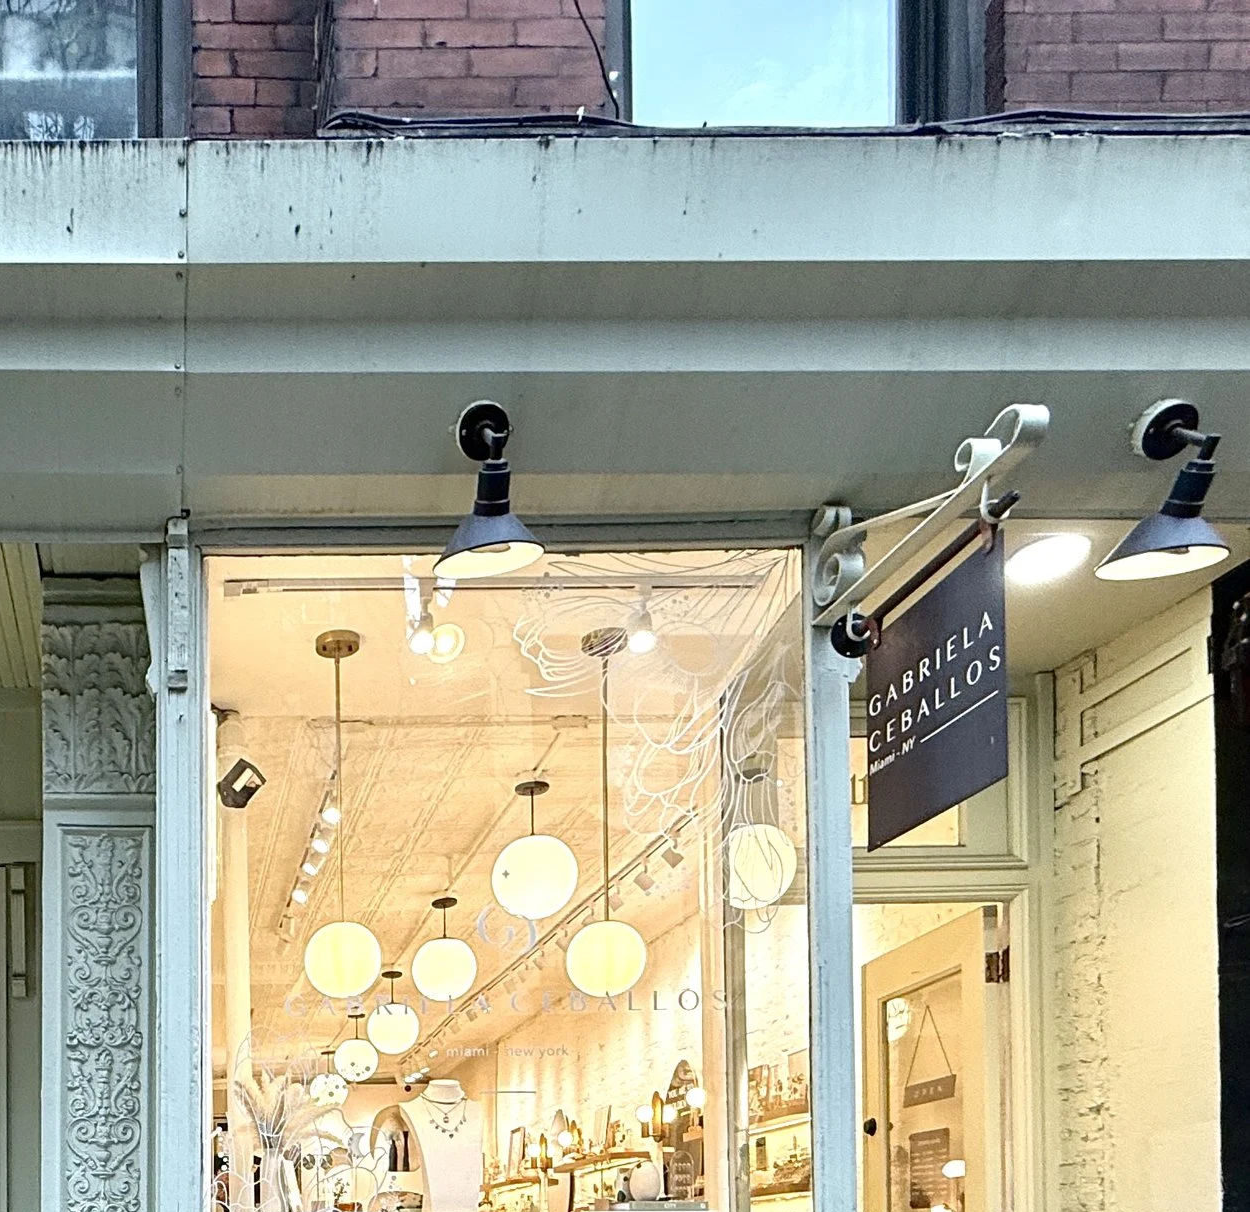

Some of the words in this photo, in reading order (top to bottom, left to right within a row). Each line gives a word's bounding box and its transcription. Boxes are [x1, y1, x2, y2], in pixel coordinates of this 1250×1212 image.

[868, 611, 994, 717] GABRIELA
[868, 645, 1001, 753] CEBALLOS
[869, 749, 896, 777] Miami
[901, 735, 917, 756] NY
[510, 987, 728, 1012] CEBALLOS
[446, 1043, 489, 1057] miami
[507, 1046, 533, 1057] new
[538, 1044, 569, 1060] york
